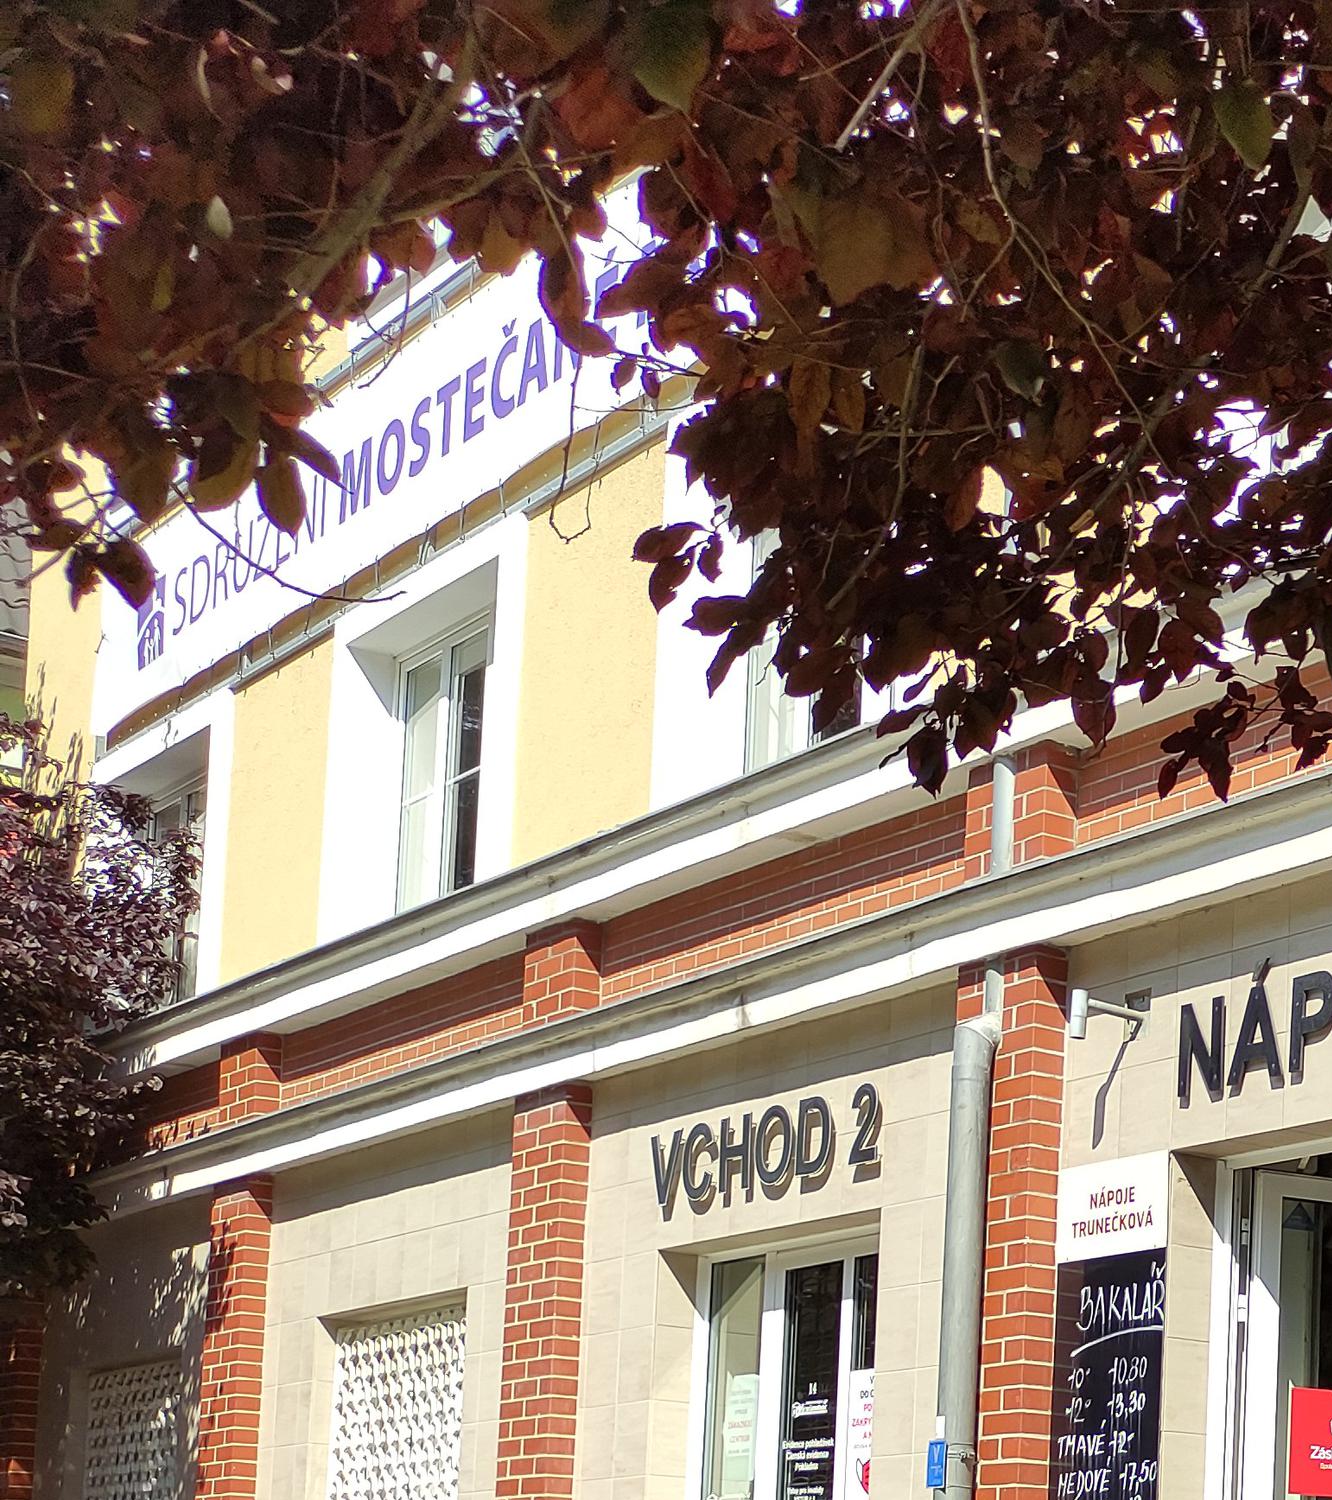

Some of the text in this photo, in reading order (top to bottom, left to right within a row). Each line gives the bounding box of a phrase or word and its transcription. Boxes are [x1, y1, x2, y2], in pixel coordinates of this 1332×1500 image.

[651, 1083, 879, 1206] VCHOD 2
[1089, 1185, 1136, 1210] NÁPOJE
[1071, 1206, 1154, 1240] TRUNEČKOVÁ
[1108, 1356, 1148, 1386] 10,80
[1107, 1390, 1147, 1420] 13,30
[1119, 1459, 1157, 1496] 17,50
